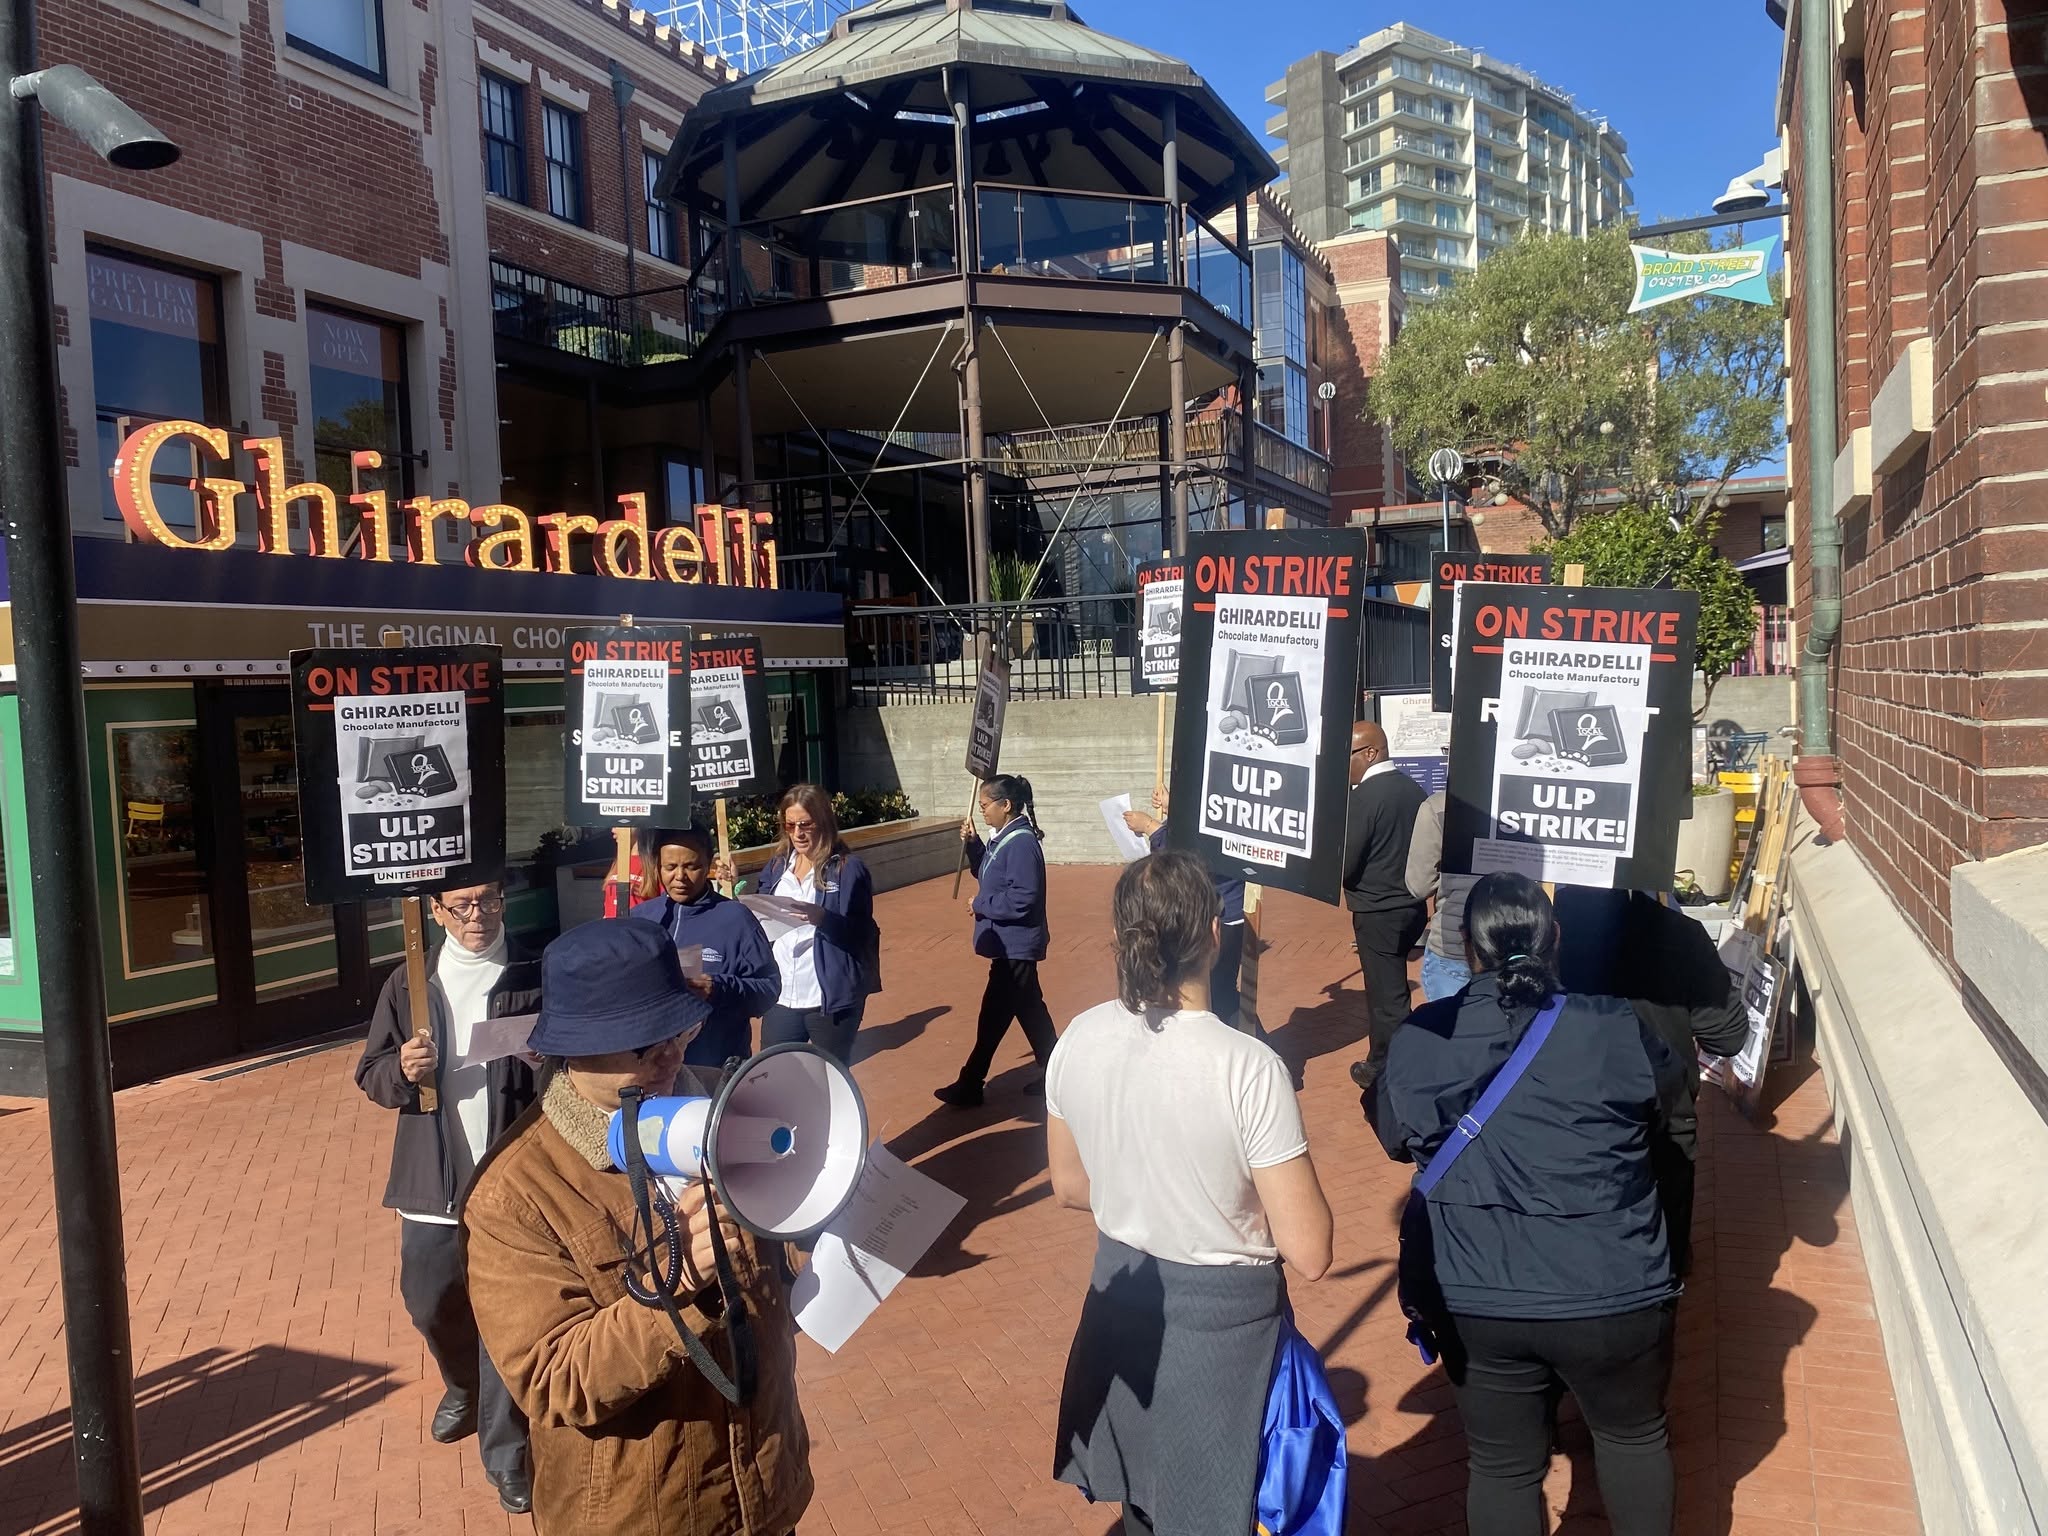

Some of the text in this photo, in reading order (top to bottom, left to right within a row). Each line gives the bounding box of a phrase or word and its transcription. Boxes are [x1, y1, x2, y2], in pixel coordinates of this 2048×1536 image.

[1641, 256, 1759, 276] BROAD STREET
[89, 263, 194, 307] PREVIEW
[1649, 273, 1730, 288] OYSTER CO.
[91, 288, 197, 329] GALLERY
[324, 320, 364, 346] NOW
[322, 341, 369, 366] OPEN
[114, 420, 779, 591] Ghirardelli
[1138, 570, 1151, 586] ON
[1195, 555, 1353, 596] ON STRIKE
[1440, 562, 1543, 584] ON STRIKE
[1219, 608, 1321, 630] GHIRARDELLI
[1475, 605, 1680, 644] ON STRIKE
[308, 623, 365, 648] THE
[1218, 630, 1319, 650] Chocolate Manufactory
[571, 640, 682, 663] ON STRIKE
[690, 648, 756, 670] STRIKE
[1153, 645, 1175, 658] ULP
[1509, 650, 1643, 671] GHIRARDELLI
[308, 662, 490, 696] ON STRIKE
[587, 668, 664, 679] GHIRARDELLI
[1508, 670, 1640, 687] Chocolate Manufactory
[621, 681, 664, 689] Manufactory
[341, 701, 460, 719] GHIRARDELLI
[343, 719, 460, 731] Chocolate Manufactory
[698, 745, 731, 760] ULP
[605, 757, 644, 775] ULP
[586, 777, 663, 795] STRIKE!
[1231, 763, 1283, 798] ULP
[1532, 784, 1596, 811] ULP
[602, 805, 648, 813] UNITEHERE!
[1207, 793, 1306, 840] STRIKE!
[379, 814, 436, 838] ULP
[1499, 810, 1626, 844] STRIKE!
[352, 835, 464, 864] STRIKE!
[1224, 840, 1284, 863] UNITEHERE!
[377, 867, 443, 881] UNITEHERE!
